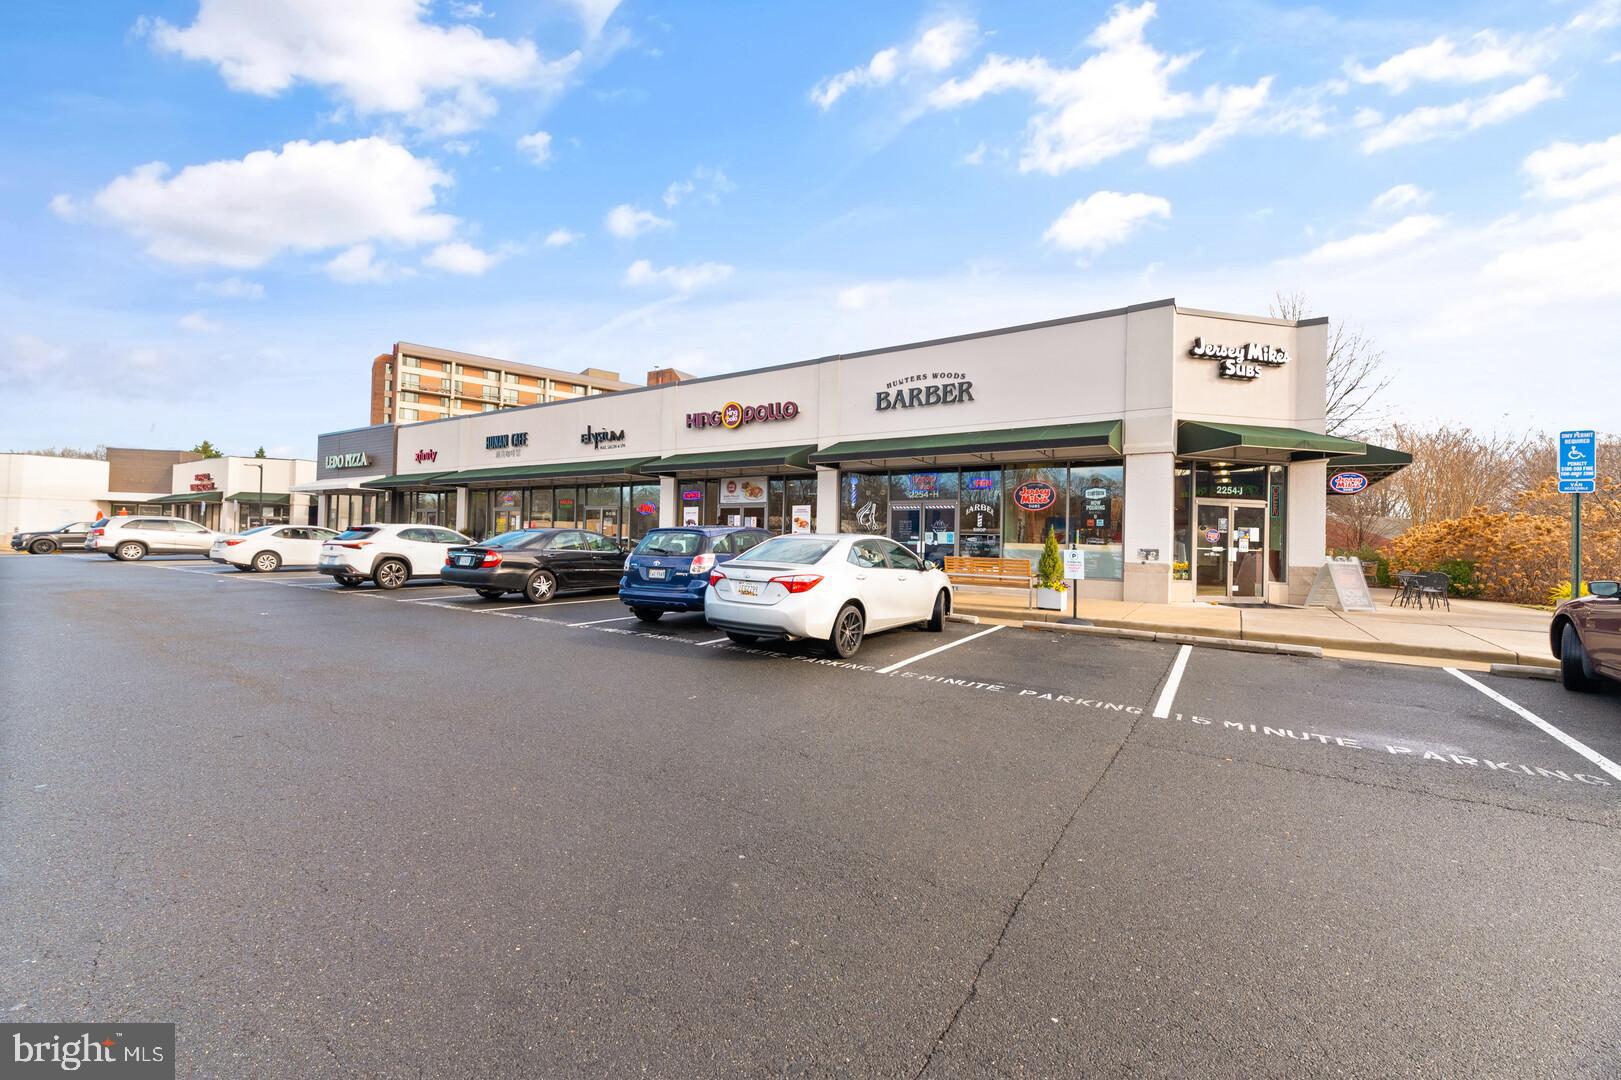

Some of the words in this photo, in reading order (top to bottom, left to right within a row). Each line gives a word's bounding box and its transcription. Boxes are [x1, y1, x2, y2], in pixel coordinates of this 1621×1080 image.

[1194, 336, 1245, 363] Jersey
[1225, 359, 1262, 377] SUBS
[886, 374, 928, 389] HUNTERS
[875, 381, 975, 411] BARBER
[743, 401, 799, 424] POLLO
[325, 454, 343, 469] LEDO
[908, 490, 938, 498] 2254-H
[1216, 486, 1243, 495] 2254-J
[791, 655, 876, 671] PARKING
[918, 673, 1005, 692] MINUTE
[1018, 689, 1144, 715] PARKING
[1175, 713, 1211, 725] 15
[1223, 721, 1363, 749] MINUTE
[1386, 744, 1611, 787] PARKING
